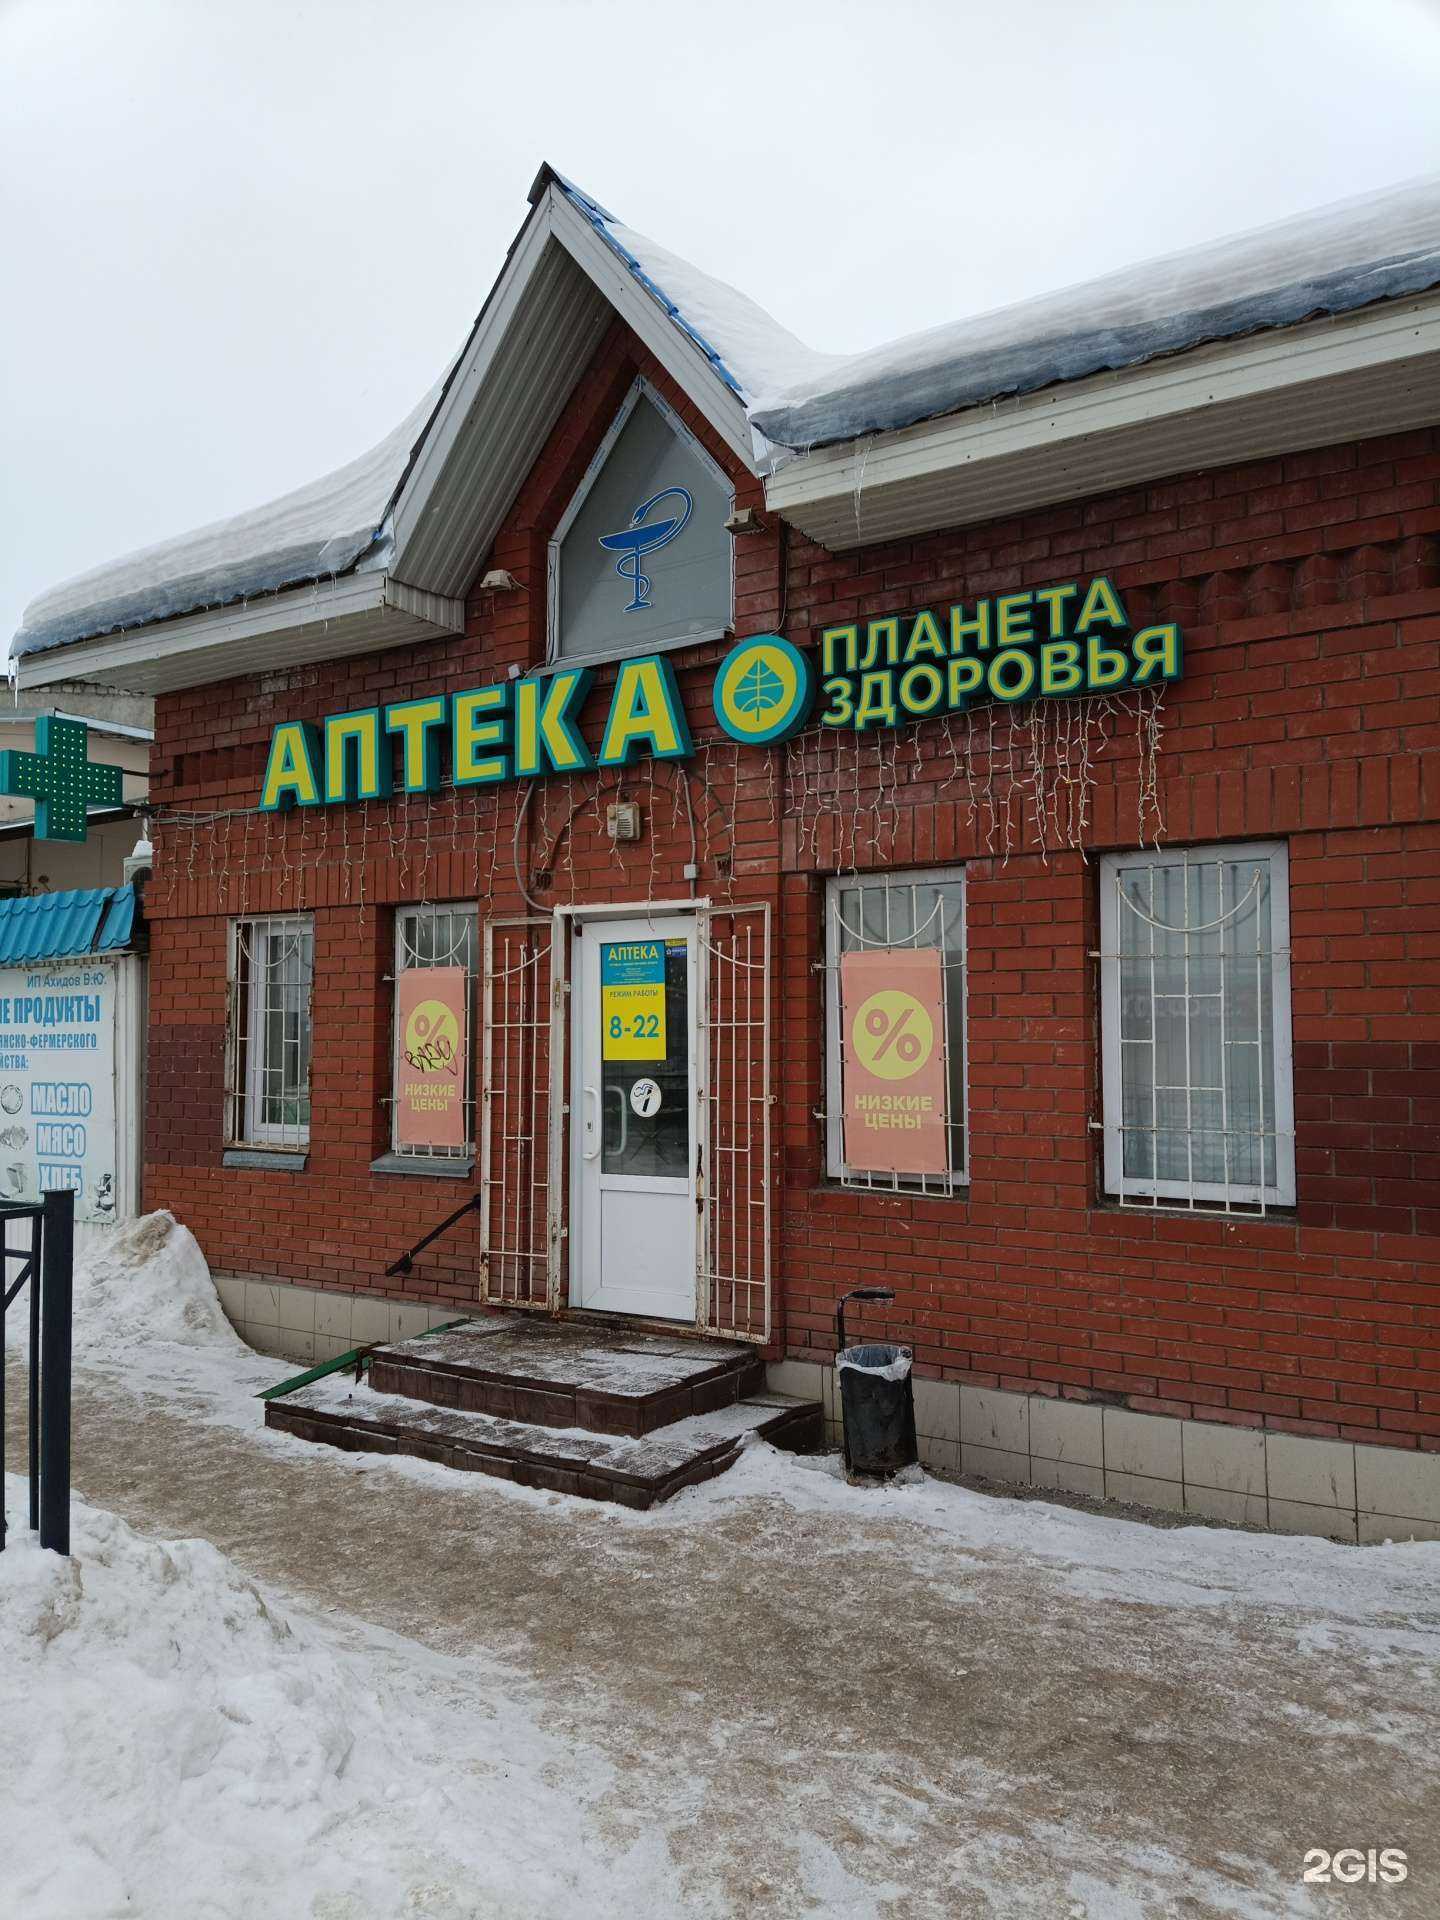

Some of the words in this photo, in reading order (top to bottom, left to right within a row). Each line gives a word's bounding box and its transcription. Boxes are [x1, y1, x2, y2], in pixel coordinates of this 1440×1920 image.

[822, 575, 1131, 676] ПЛАНЕТА
[822, 623, 1185, 731] ЗДОРОВЬЯ
[258, 655, 693, 812] АПТЕКА
[608, 945, 659, 961] АПТЕКА
[27, 975, 41, 988] ИП
[0, 997, 11, 1024] Е
[13, 994, 101, 1027] ПРОДУКТЫ
[31, 1082, 92, 1117] МАСЛО
[405, 1083, 456, 1097] НИЗКИЕ
[411, 1098, 448, 1112] ЦЕНЫ
[854, 1094, 934, 1112] НИЗКИЕ
[864, 1112, 922, 1130] ЦЕНЫ
[37, 1122, 86, 1157] МЯСО
[39, 1163, 83, 1198] ХЛЕБ
